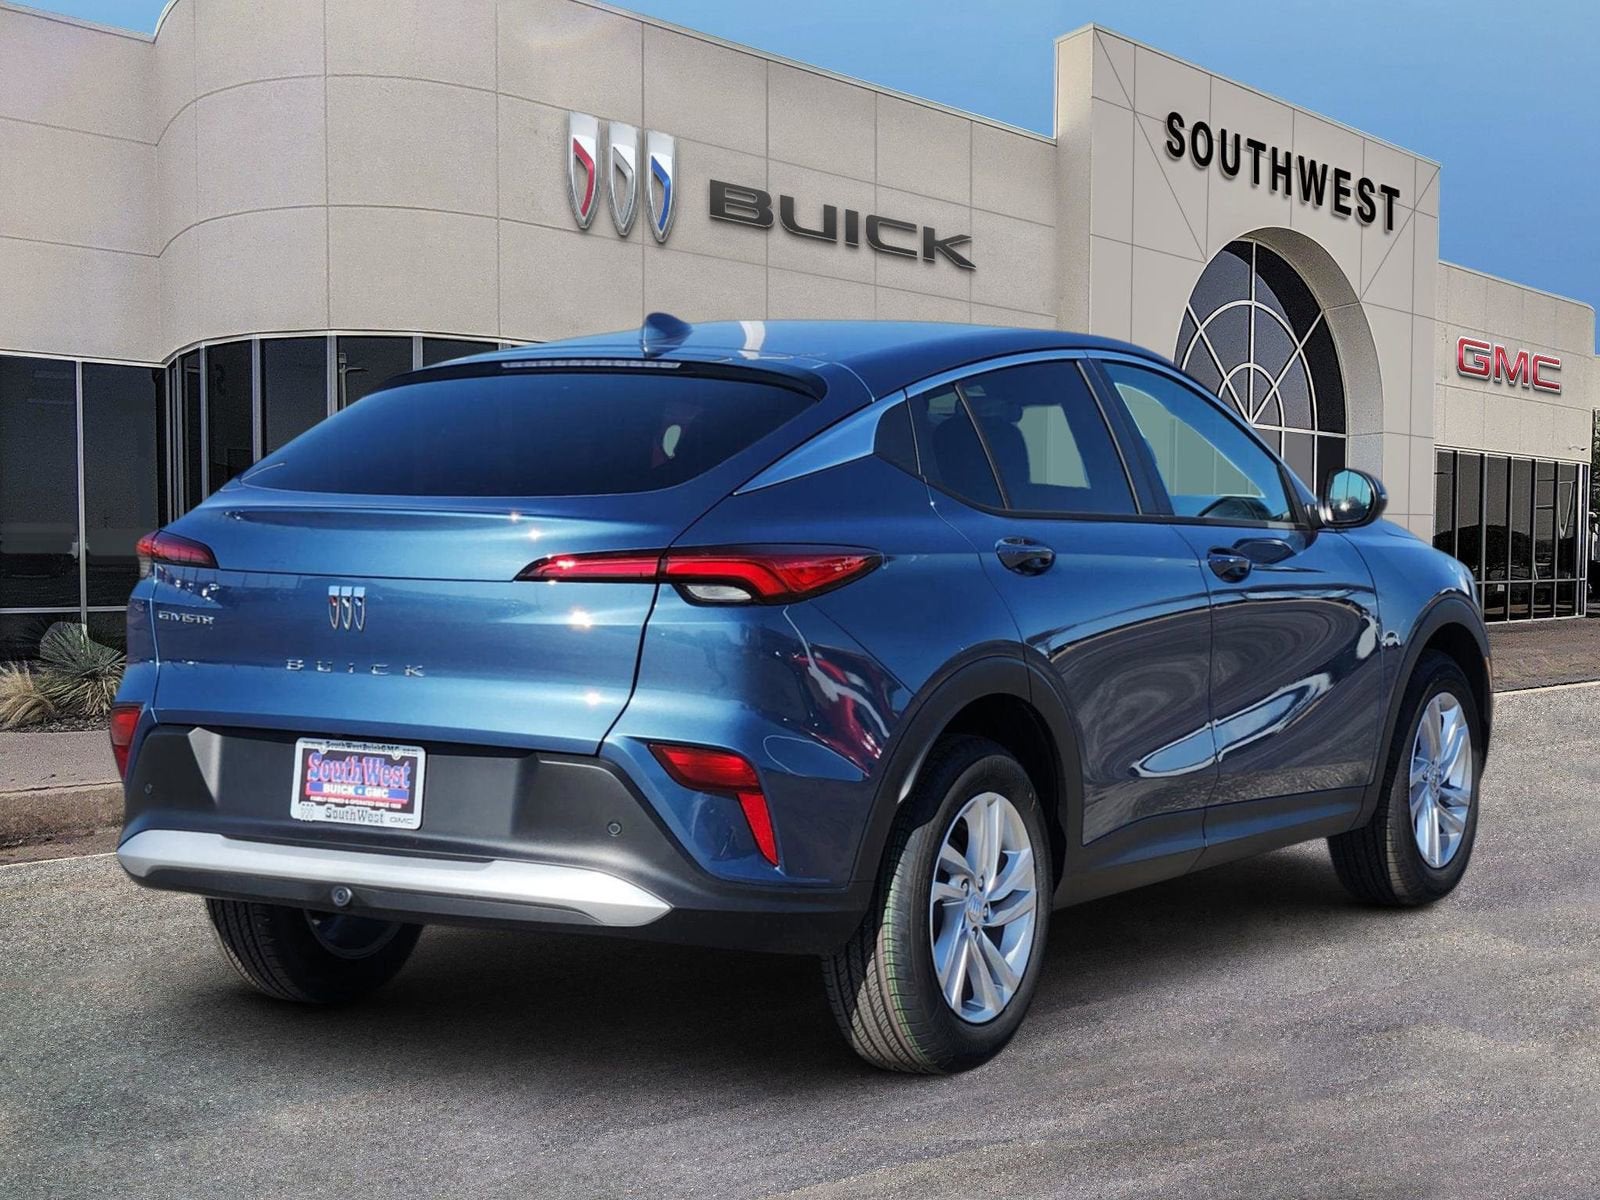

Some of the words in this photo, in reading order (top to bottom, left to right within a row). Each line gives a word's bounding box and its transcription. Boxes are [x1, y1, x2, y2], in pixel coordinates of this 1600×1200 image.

[1165, 111, 1400, 232] SOUTHWEST
[709, 179, 977, 270] BUICK
[1457, 336, 1561, 394] GMC
[286, 659, 425, 677] BUICK
[323, 782, 355, 796] BUICK
[367, 787, 389, 799] GMC
